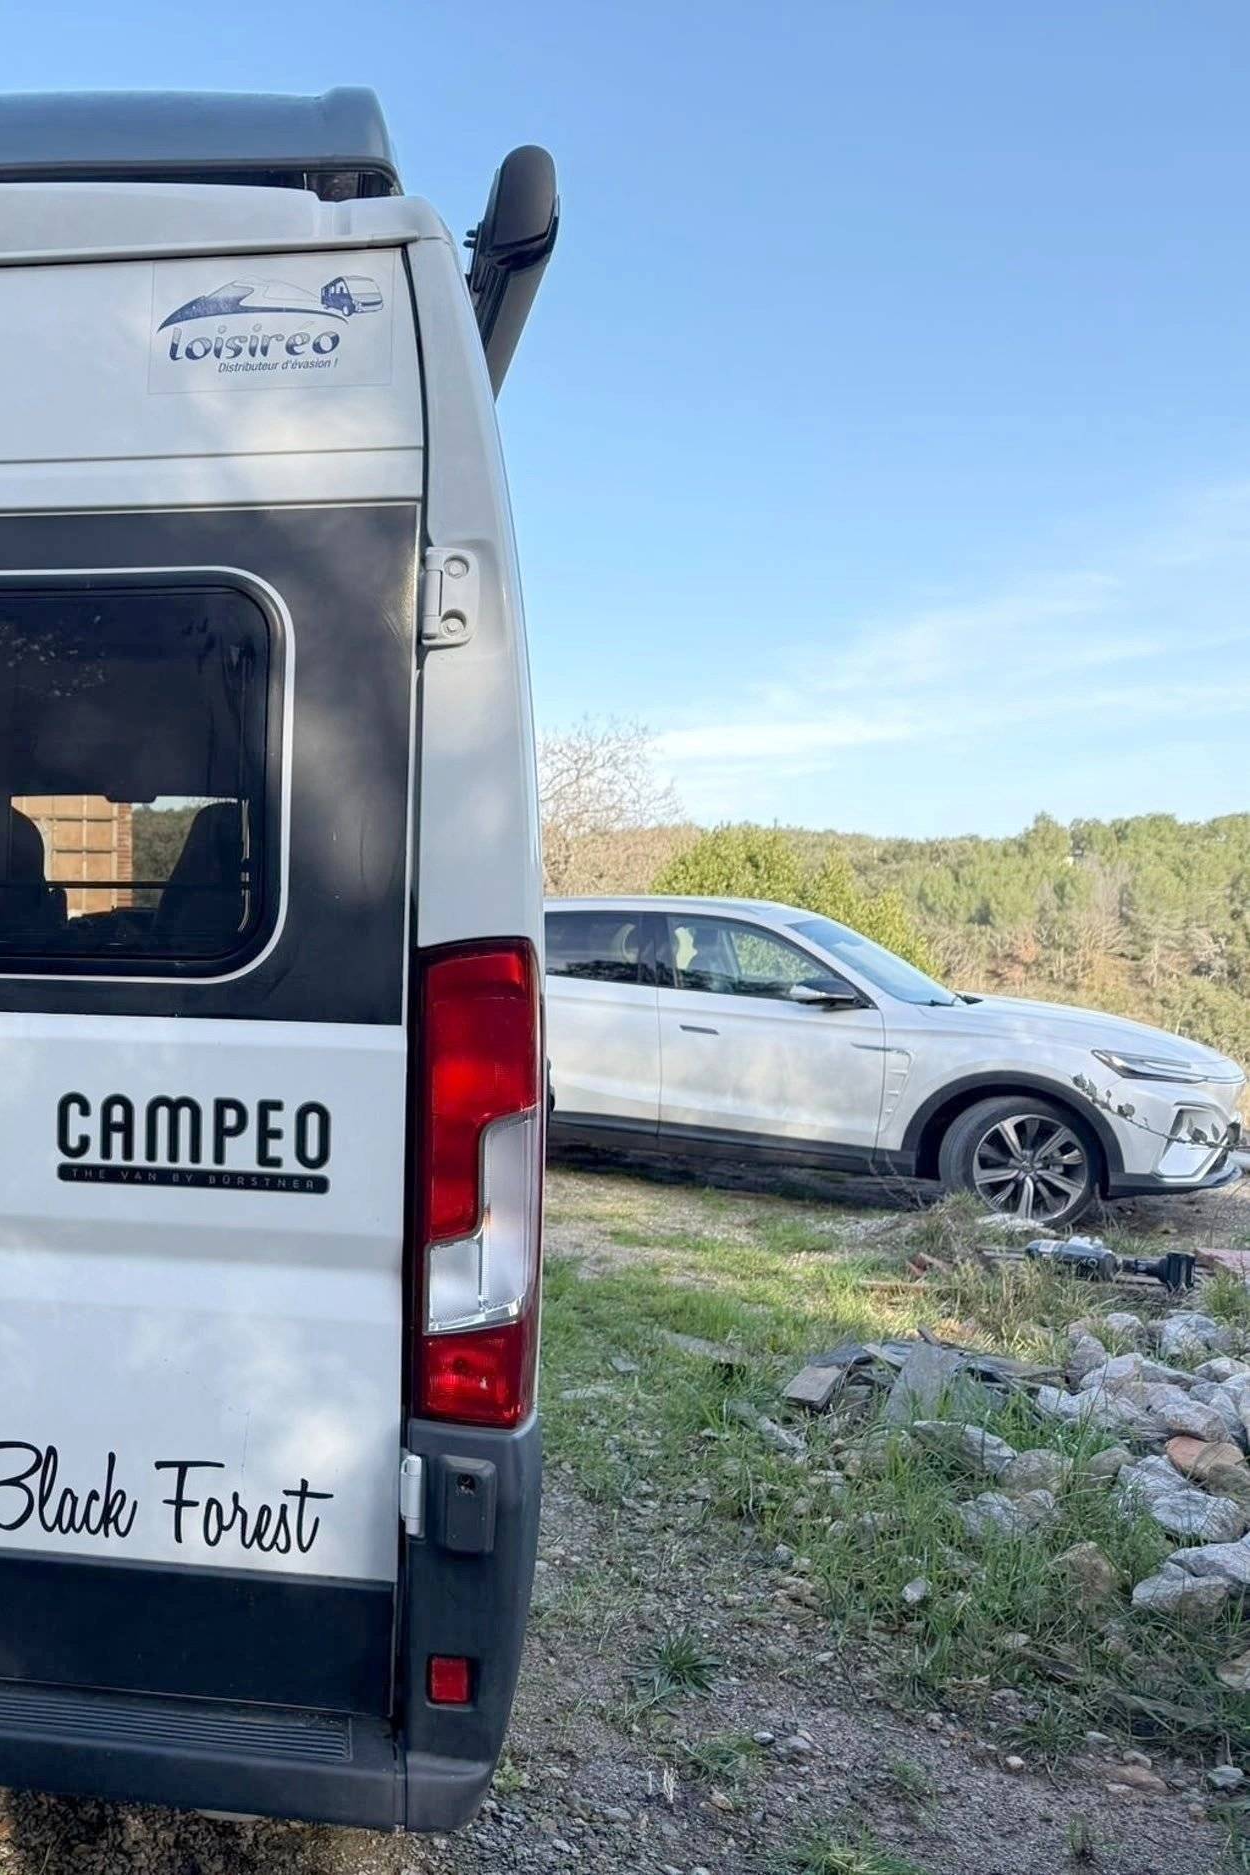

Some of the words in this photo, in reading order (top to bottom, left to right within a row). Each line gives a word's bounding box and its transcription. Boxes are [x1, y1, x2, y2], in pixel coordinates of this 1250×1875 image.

[217, 361, 279, 373] Distributeur
[281, 359, 331, 370] d'évasion
[56, 1091, 331, 1170] CAMPEO
[70, 1168, 106, 1180] THE
[119, 1170, 158, 1182] VAN
[171, 1172, 194, 1184] BY
[154, 1459, 334, 1554] Forest
